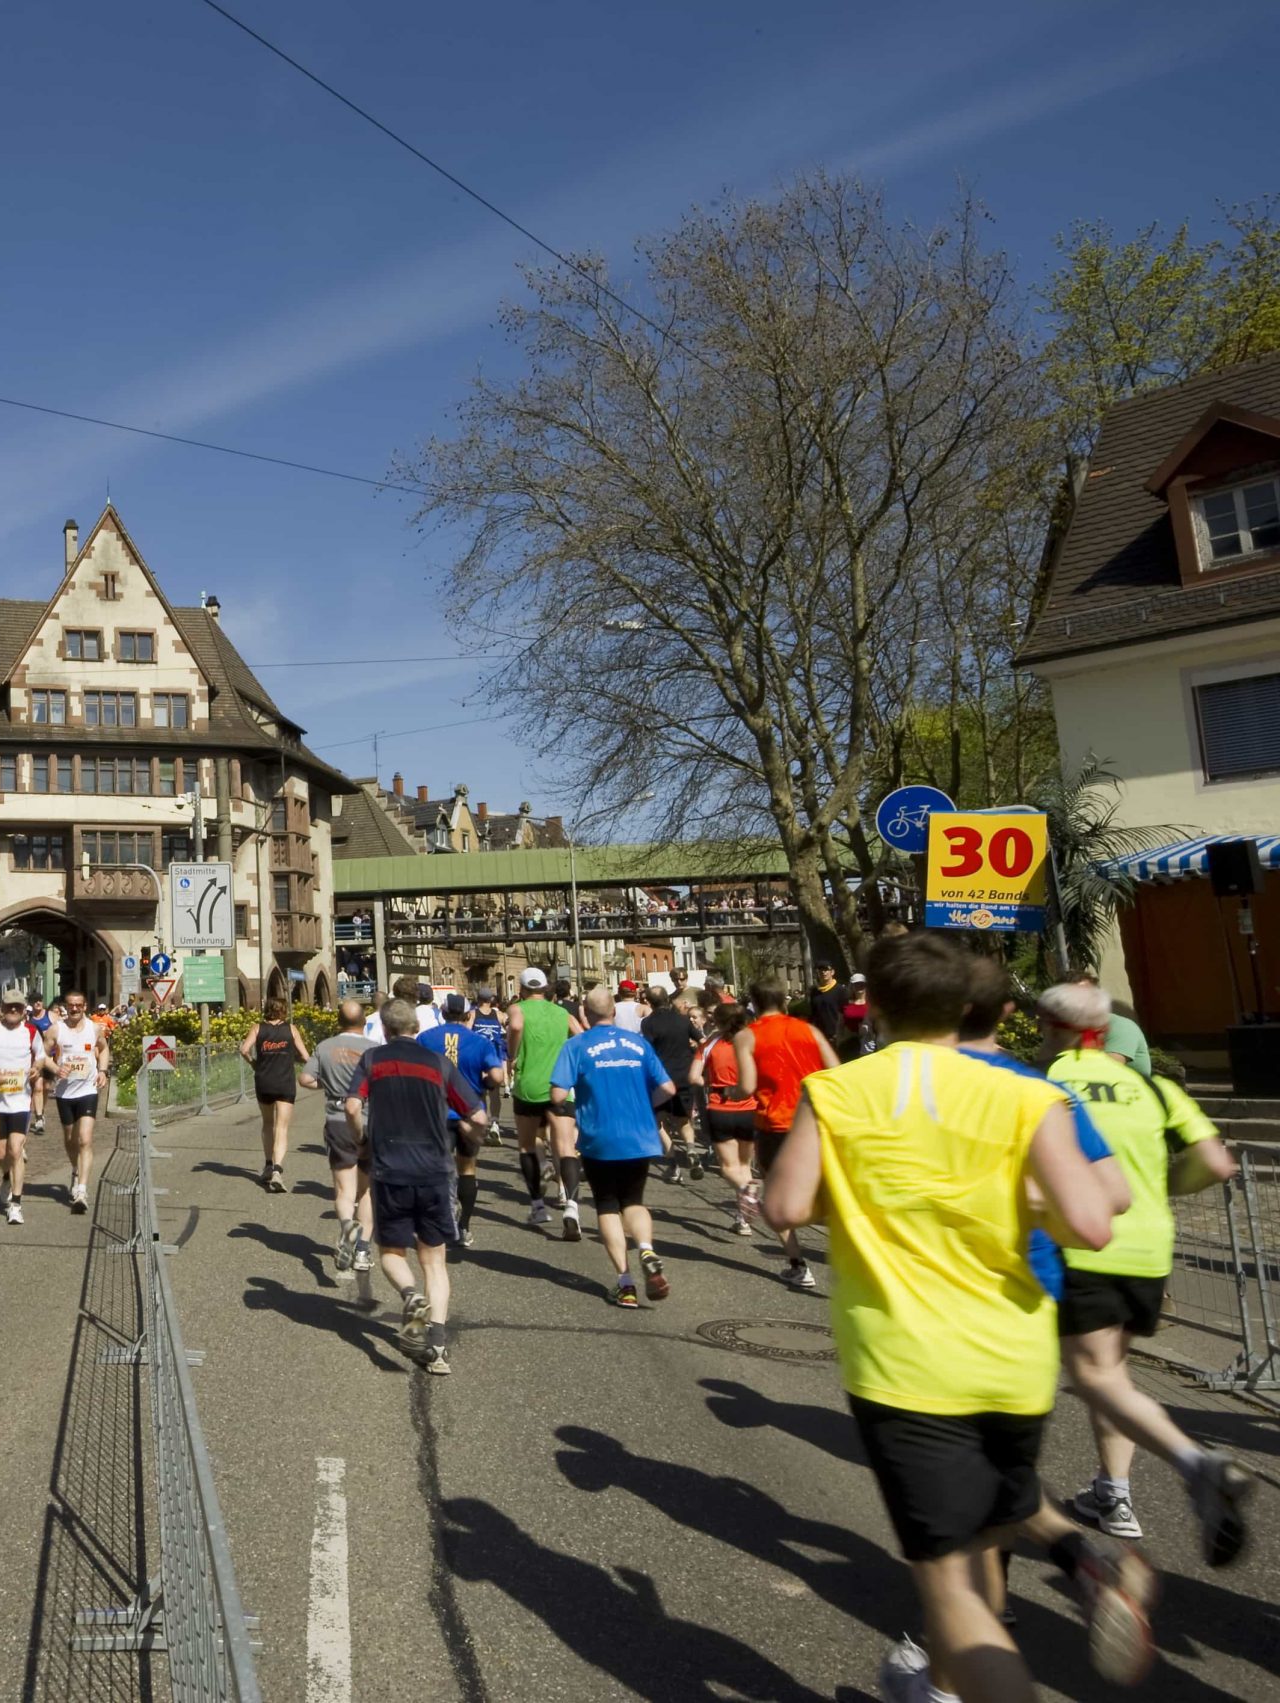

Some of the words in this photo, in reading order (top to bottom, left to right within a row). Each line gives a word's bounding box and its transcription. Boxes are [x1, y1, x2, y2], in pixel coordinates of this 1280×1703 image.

[940, 826, 1034, 878] 30
[174, 867, 217, 876] Stadtmitte
[941, 889, 964, 898] von
[967, 889, 985, 900] 42
[988, 890, 1030, 901] Bands
[180, 937, 225, 946] Umfahrung
[444, 1032, 460, 1047] M
